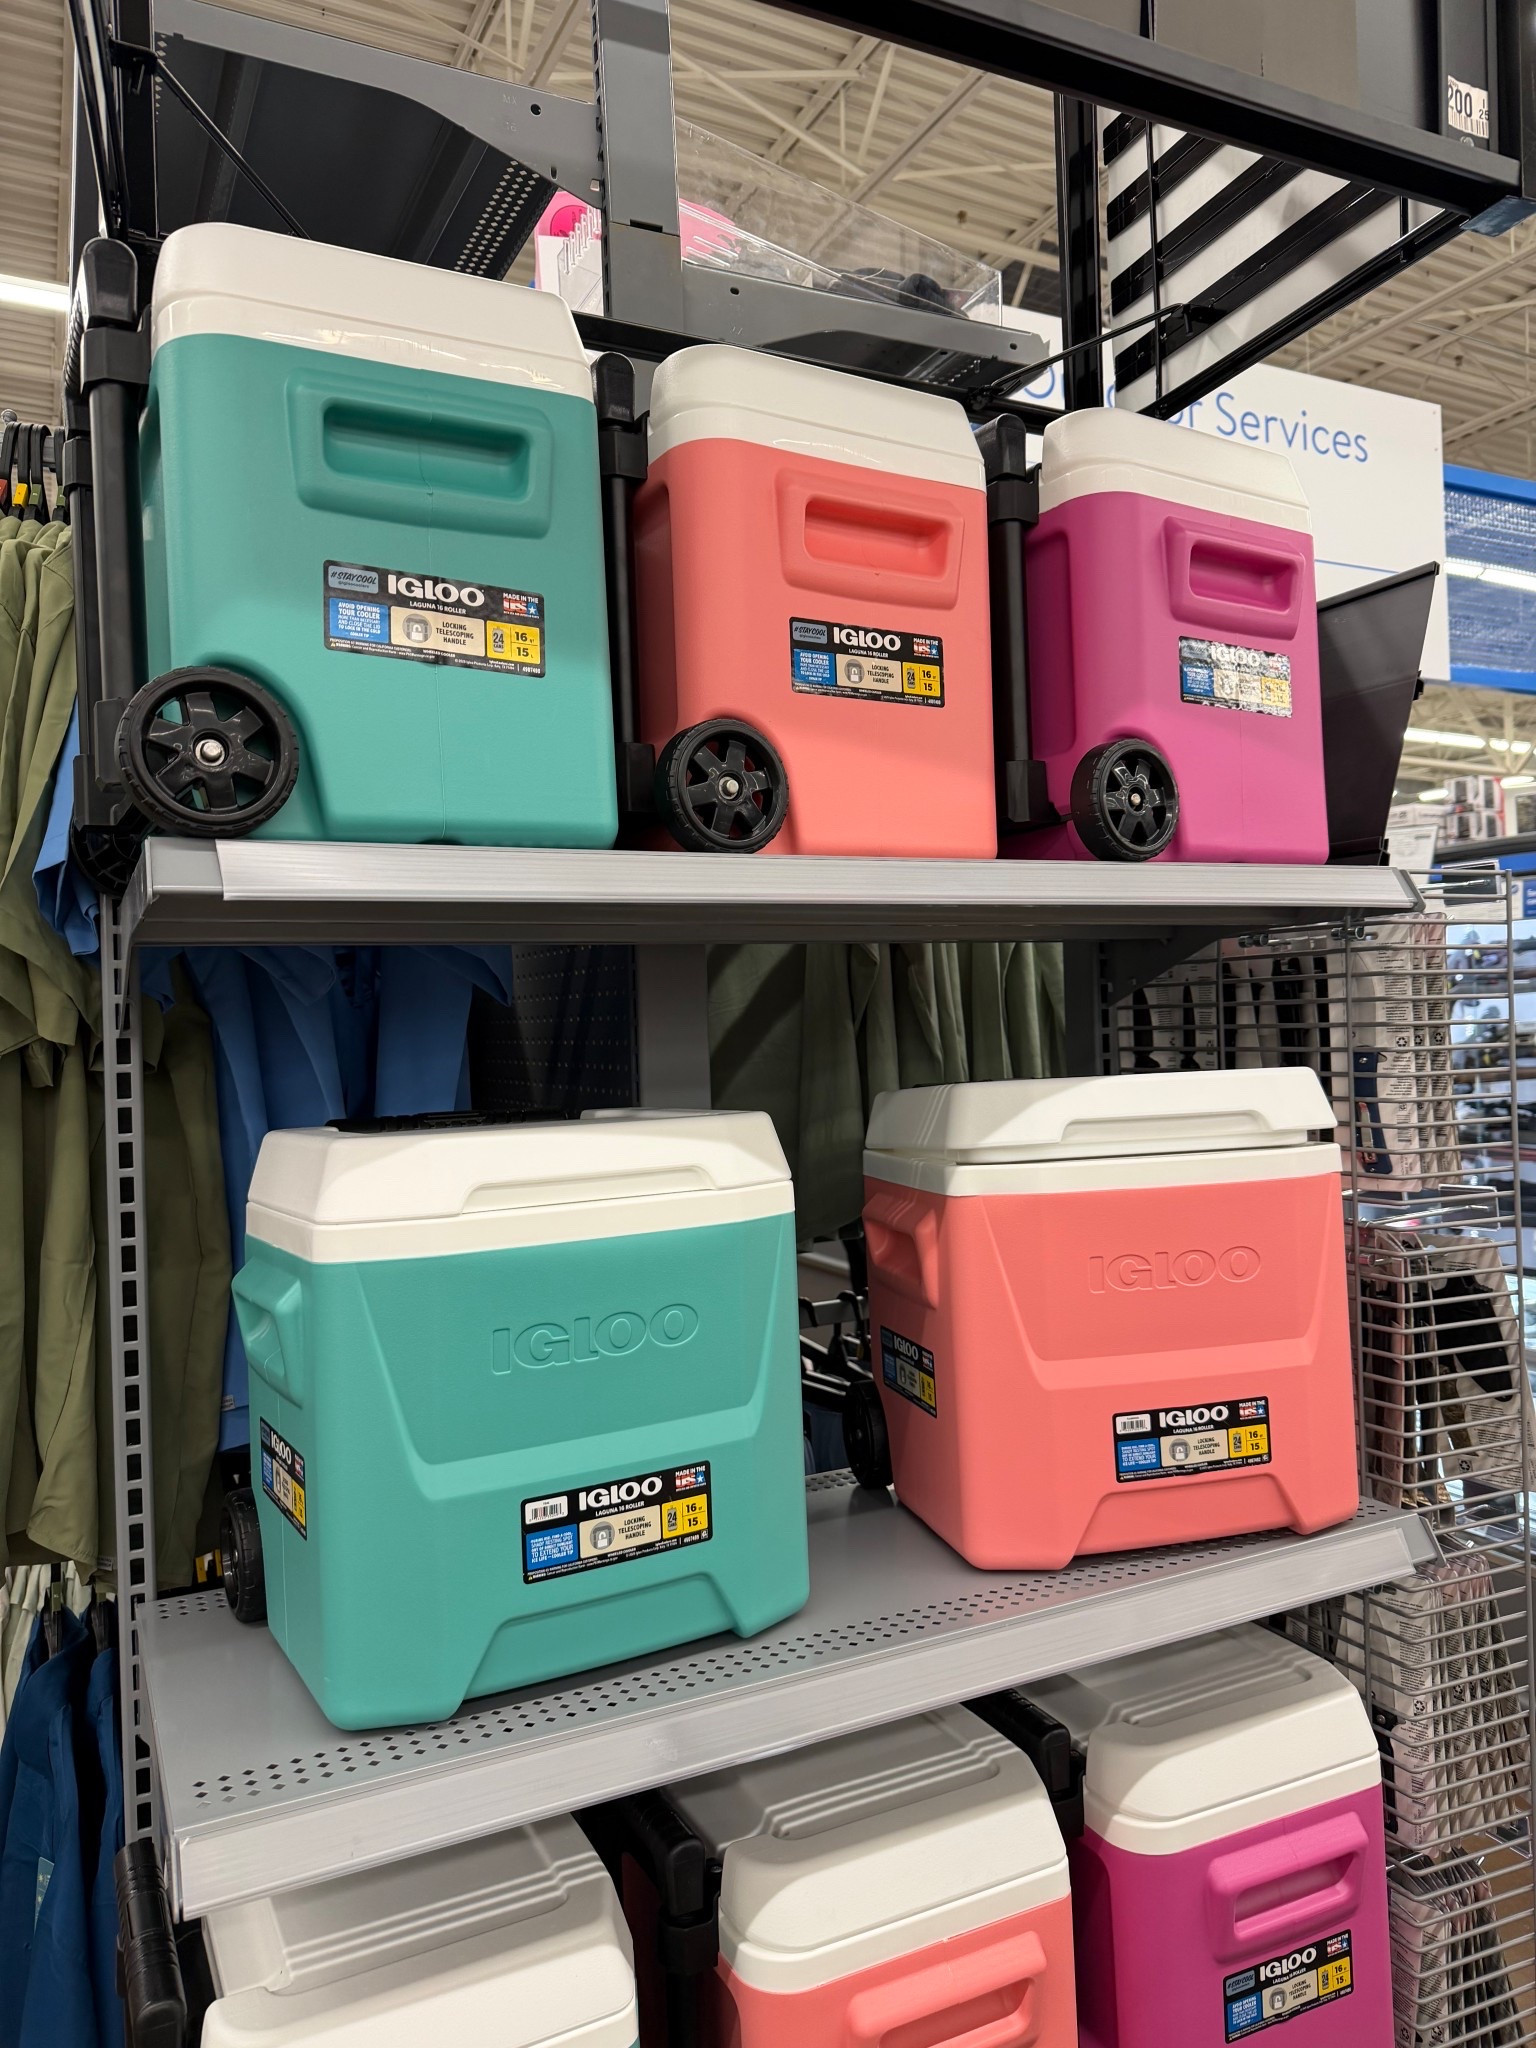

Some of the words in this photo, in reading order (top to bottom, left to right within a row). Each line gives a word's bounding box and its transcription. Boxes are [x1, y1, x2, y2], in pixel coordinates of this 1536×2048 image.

[1215, 391, 1369, 463] Services
[331, 571, 377, 584] #STAYCOOL
[387, 574, 485, 607] IGLOO
[338, 602, 355, 610] AVOID
[356, 604, 380, 612] OPENING
[409, 601, 436, 610] LAGUNA
[444, 605, 467, 614] ROLLER
[338, 608, 355, 616] YOUR
[357, 611, 380, 619] COOLER
[442, 622, 467, 631] LOCKING
[436, 628, 474, 639] TELESCOPING
[493, 633, 504, 644] 24
[514, 631, 528, 642] 16
[833, 626, 901, 651] IGLOO
[443, 637, 466, 645] HANDLE
[516, 646, 529, 657] 15
[1211, 644, 1260, 667] IGLOO
[867, 670, 894, 678] TELESCOPING
[907, 671, 915, 681] 24
[922, 670, 932, 678] 16
[924, 683, 933, 691] 15
[1088, 1246, 1262, 1294] IGLOO
[492, 1303, 699, 1375] IGLOO
[894, 1335, 918, 1360] IGLOO
[1159, 1405, 1229, 1428] IGLOO
[1249, 1431, 1258, 1439] 16
[1193, 1442, 1220, 1450] TELESCOPING
[1233, 1437, 1242, 1445] 24
[270, 1430, 292, 1465] IGLOO
[579, 1476, 663, 1511] IGLOO
[595, 1507, 618, 1517] LAGUNA
[625, 1501, 644, 1510] ROLLER
[686, 1503, 697, 1513] 16
[624, 1516, 646, 1526] LOCKING
[667, 1512, 677, 1524] 24
[687, 1517, 698, 1527] 15
[618, 1521, 652, 1534] TELESCOPING
[625, 1530, 645, 1540] HANDLE
[540, 1548, 559, 1556] EXTEND
[1260, 1947, 1317, 1982] IGLOO
[1334, 1965, 1343, 1974] 16
[1292, 1979, 1307, 1989] LOCKING
[1336, 1976, 1344, 1985] 15
